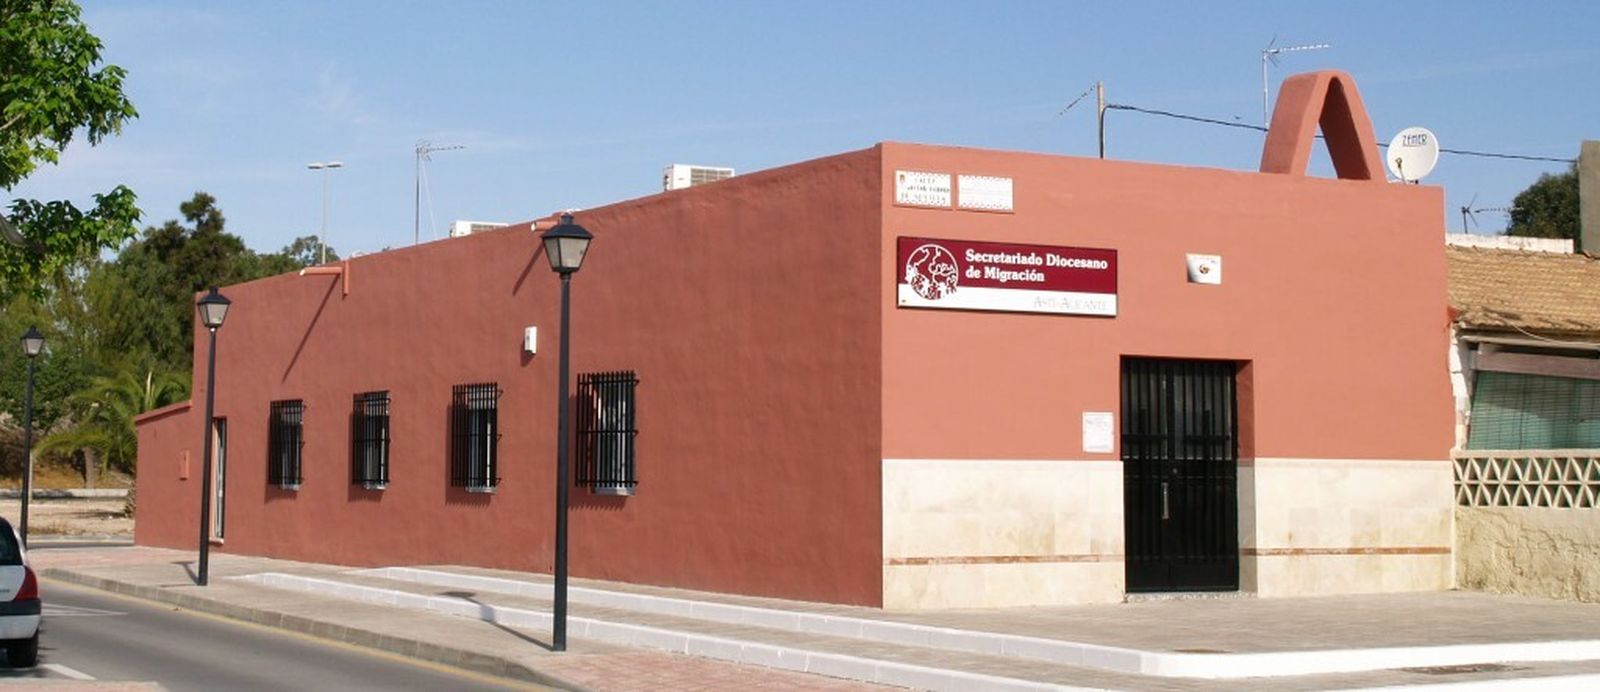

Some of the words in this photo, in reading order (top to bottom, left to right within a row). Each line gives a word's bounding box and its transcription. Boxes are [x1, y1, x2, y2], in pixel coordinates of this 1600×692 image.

[965, 248, 1043, 266] Secretariado
[1046, 254, 1108, 270] Diocesano
[965, 265, 981, 278] de
[984, 266, 1045, 283] Migración
